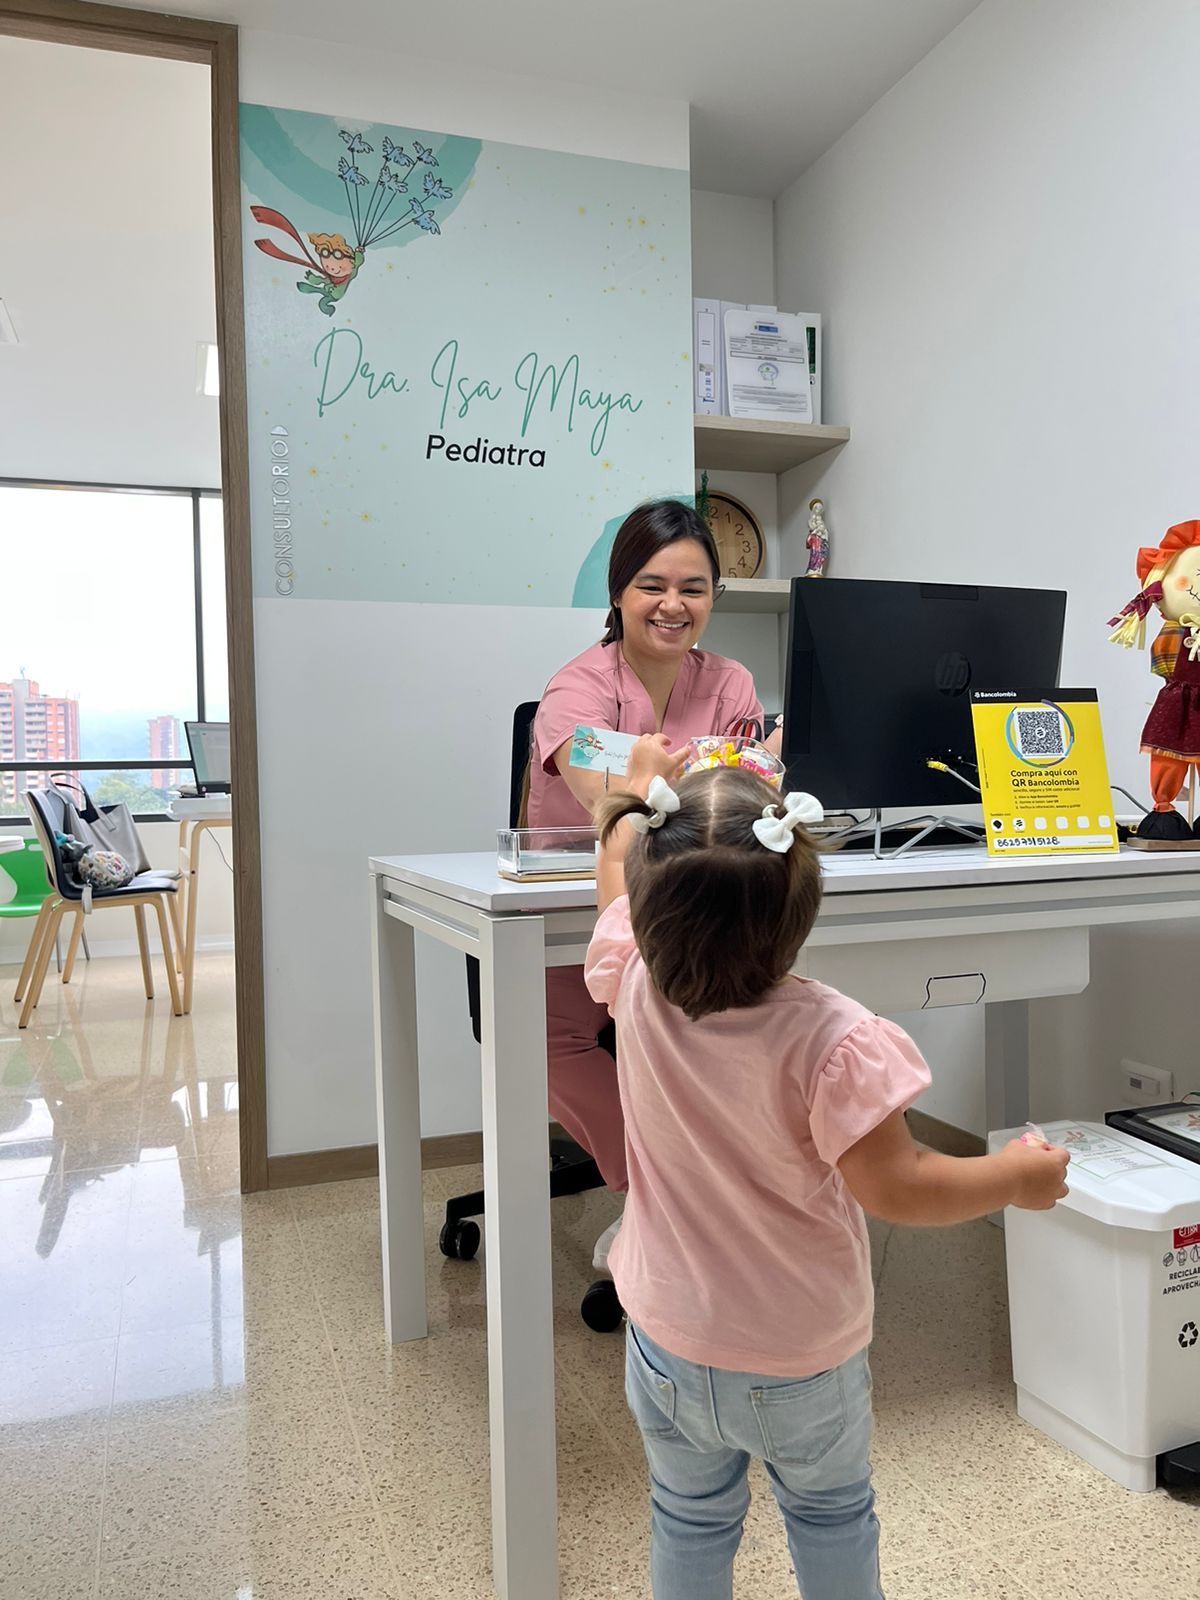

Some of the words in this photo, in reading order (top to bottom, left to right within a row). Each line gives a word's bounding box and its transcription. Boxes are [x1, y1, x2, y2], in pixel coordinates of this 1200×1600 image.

[313, 327, 411, 418] Dra.
[431, 339, 502, 430] Isa
[514, 352, 644, 457] Maya
[425, 434, 547, 468] Pediatra
[270, 439, 295, 597] CONSULTORIO
[724, 511, 731, 524] 1
[735, 523, 745, 536] 2
[742, 540, 752, 554] 3
[737, 555, 747, 569] 4
[728, 567, 738, 579] 5
[1010, 769, 1043, 778] Compra
[1011, 778, 1027, 787] QR
[1028, 778, 1080, 787] Bancolombia
